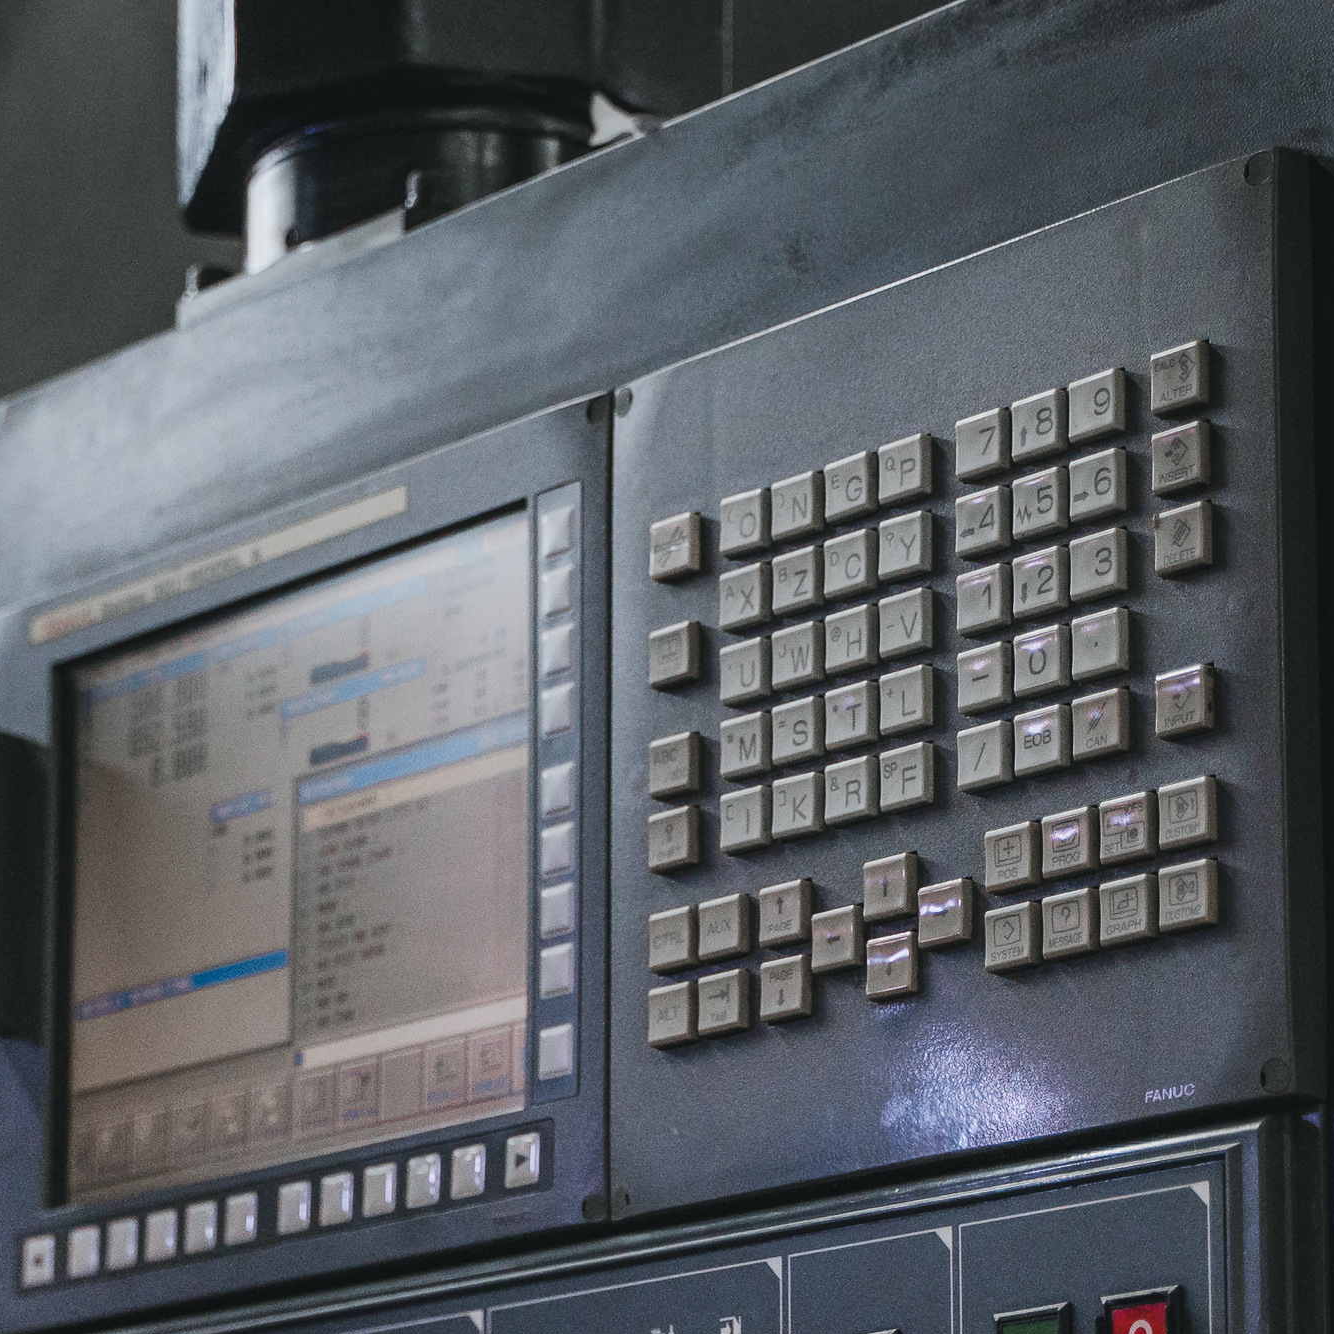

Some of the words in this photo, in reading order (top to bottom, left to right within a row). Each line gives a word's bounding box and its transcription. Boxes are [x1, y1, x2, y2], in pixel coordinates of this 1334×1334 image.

[1094, 388, 1111, 416] 9
[1161, 385, 1192, 401] ALTER
[1036, 407, 1053, 436] 8
[979, 426, 995, 455] 7
[900, 458, 915, 486] P
[1094, 467, 1111, 496] 6
[1159, 464, 1196, 481] INSERT
[845, 476, 862, 502] G
[1037, 485, 1053, 515] 5
[791, 492, 807, 522] N
[979, 504, 994, 530] 4
[900, 534, 917, 561] Y
[1164, 549, 1196, 566] DELETE
[845, 556, 861, 580] C
[1095, 548, 1112, 576] 3
[794, 569, 809, 598] Z
[1038, 566, 1054, 594] 2
[739, 586, 755, 614] X
[983, 584, 991, 610] 1
[901, 611, 917, 639] V
[846, 629, 861, 657] H
[792, 644, 809, 673] W
[740, 660, 755, 687] U
[845, 703, 861, 730] T
[902, 691, 917, 716] L
[1164, 710, 1195, 728] INPUT
[793, 720, 808, 746] S
[1024, 729, 1051, 748] EOB
[1086, 735, 1107, 749] CAN
[739, 733, 756, 762] M
[845, 779, 861, 806] R
[902, 765, 917, 794] F
[792, 795, 807, 822] K
[1051, 854, 1081, 866] PROG
[998, 869, 1018, 881] POS
[707, 920, 731, 936] AUX
[768, 920, 792, 934] PAGE
[1049, 932, 1083, 948] MESSAGE
[1105, 920, 1141, 936] GRAPH
[991, 946, 1024, 962] SYSTEM
[769, 969, 793, 982] PAGE
[1145, 1083, 1195, 1103] FANUC
